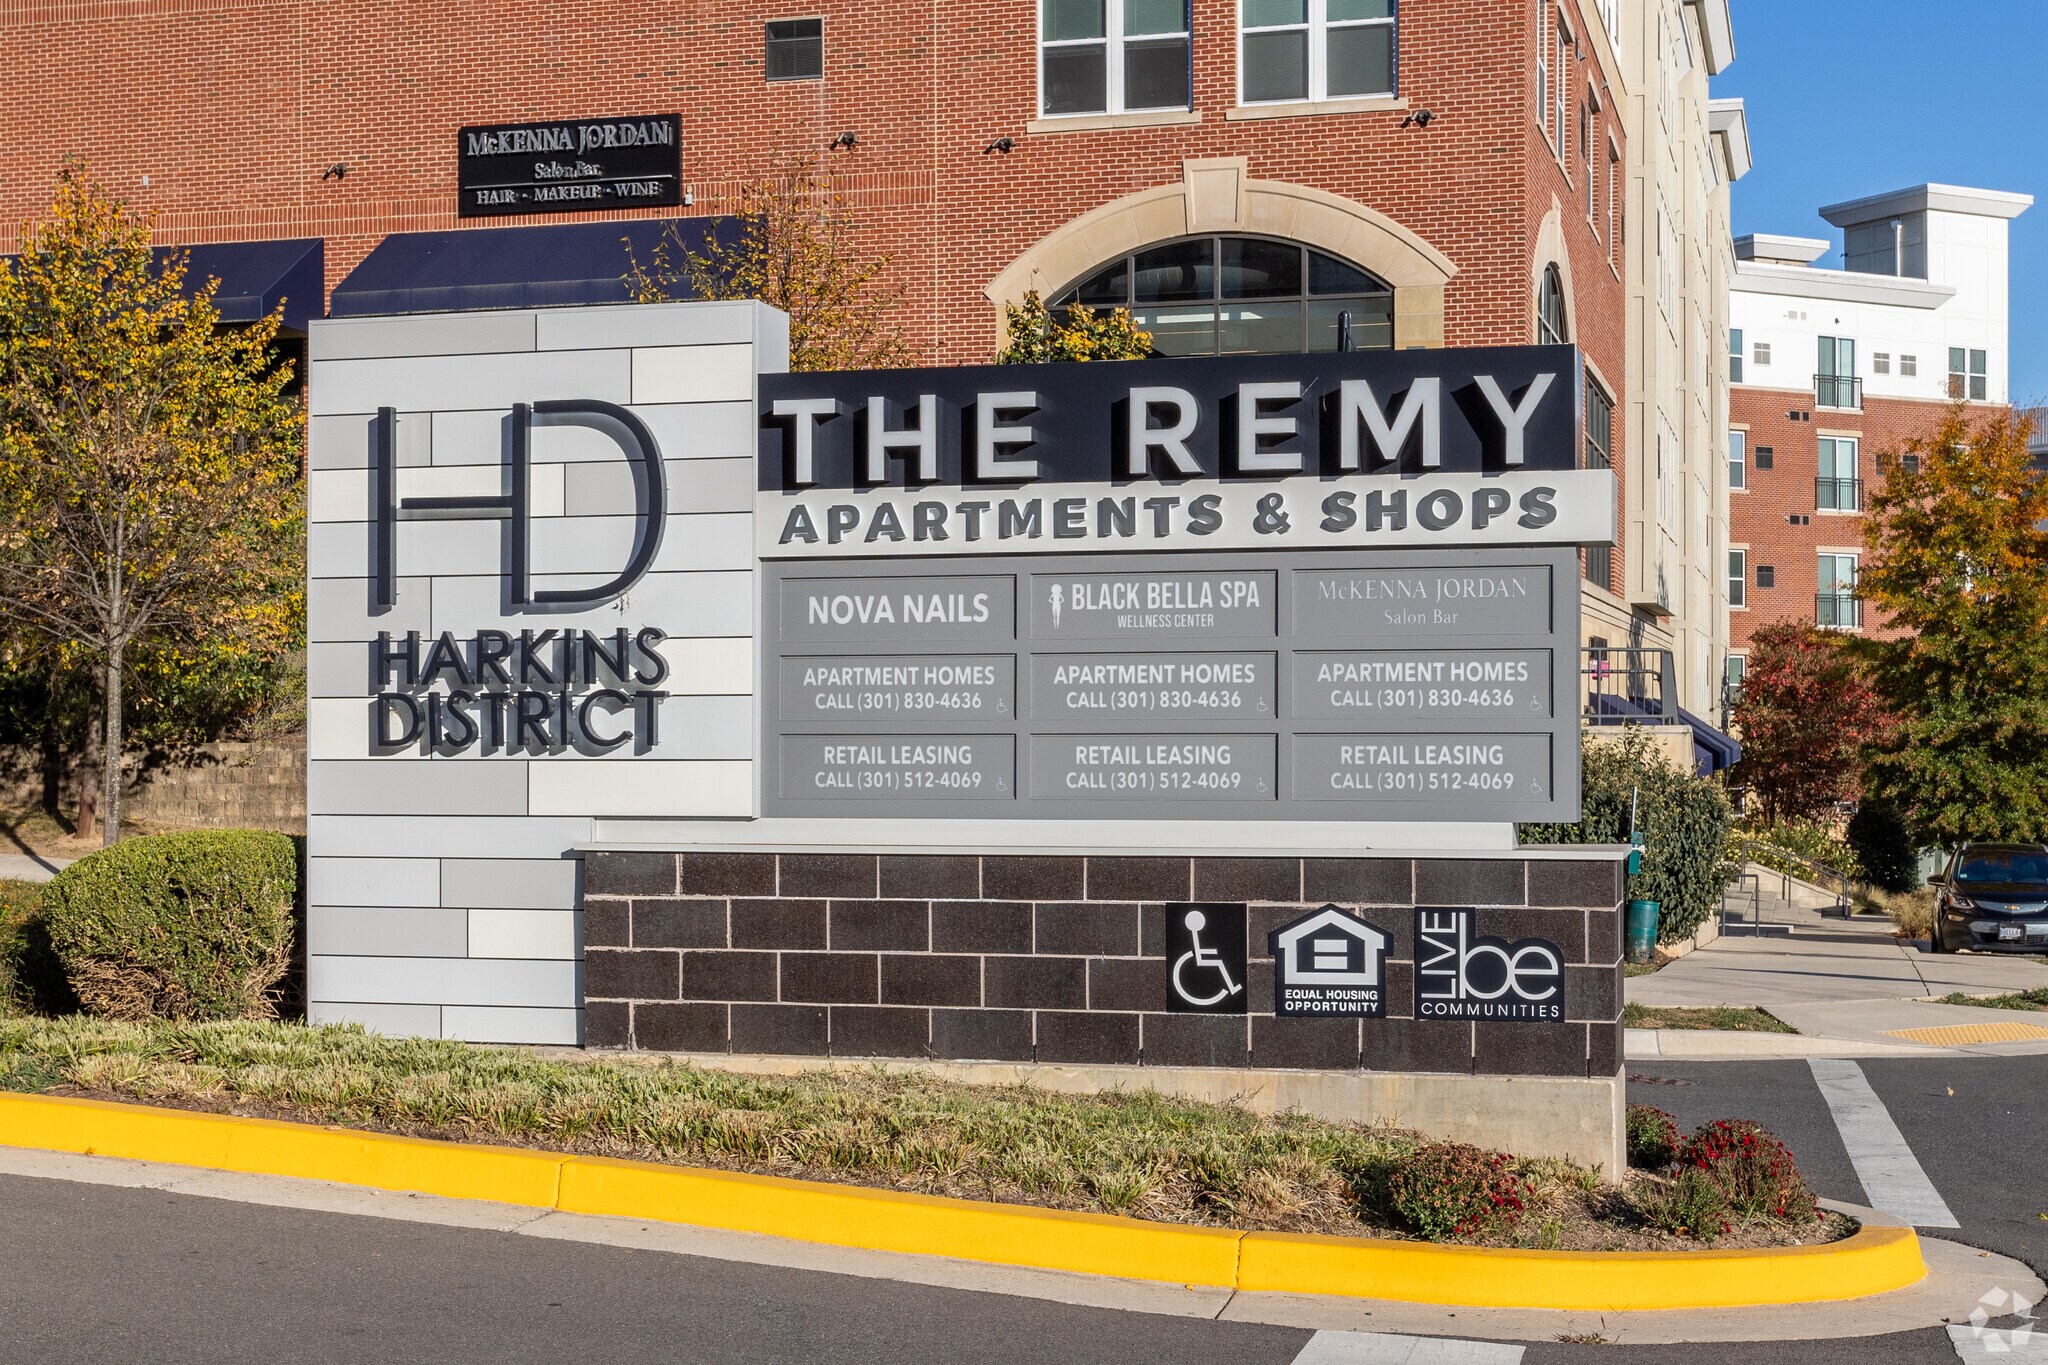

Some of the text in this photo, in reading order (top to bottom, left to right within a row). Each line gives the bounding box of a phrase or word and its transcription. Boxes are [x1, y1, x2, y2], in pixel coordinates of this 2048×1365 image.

[467, 121, 669, 156] McKENNA JORDAN
[535, 162, 599, 178] Salon Bar
[477, 182, 658, 204] HAIR MAKEUP WINE
[772, 373, 1557, 484] THE REMY
[780, 487, 1557, 545] APARTMENTS & SHOPS
[1072, 580, 1260, 610] BLACK BELLA SPA
[1318, 578, 1527, 603] McKENNA JORDAN
[808, 593, 989, 624] NOVA NAILS
[1384, 609, 1458, 624] Salon Bar
[1118, 614, 1214, 628] WELLNESS CENTER
[376, 627, 670, 686] HARKINS
[803, 666, 995, 685] APARTMENT HOMES
[1054, 664, 1255, 684] APARTMENT HOMES
[1317, 662, 1528, 682] APARTMENT HOMES
[815, 692, 982, 711] CALL (301) 830-4636
[1067, 691, 1241, 710] CALL (301) 830-4636
[1331, 689, 1514, 709] CALL (301) 830-4636
[376, 689, 670, 747] DISTRICT
[824, 746, 972, 764] RETAIL LEASING
[1076, 746, 1231, 764] RETAIL LEASING
[1341, 745, 1503, 764] RETAIL LEASING
[815, 772, 981, 790] CALL (301) 512-4069
[1066, 772, 1241, 791] CALL (301) 512-4069
[1331, 772, 1514, 791] CALL (301) 512-4069
[1421, 911, 1457, 999] LIVE
[1459, 912, 1559, 1000] be
[1285, 989, 1378, 1001] EQUAL HOUSING
[1285, 1001, 1378, 1012] OPPORTUNITY
[1421, 1002, 1559, 1018] COMMUNITIES
